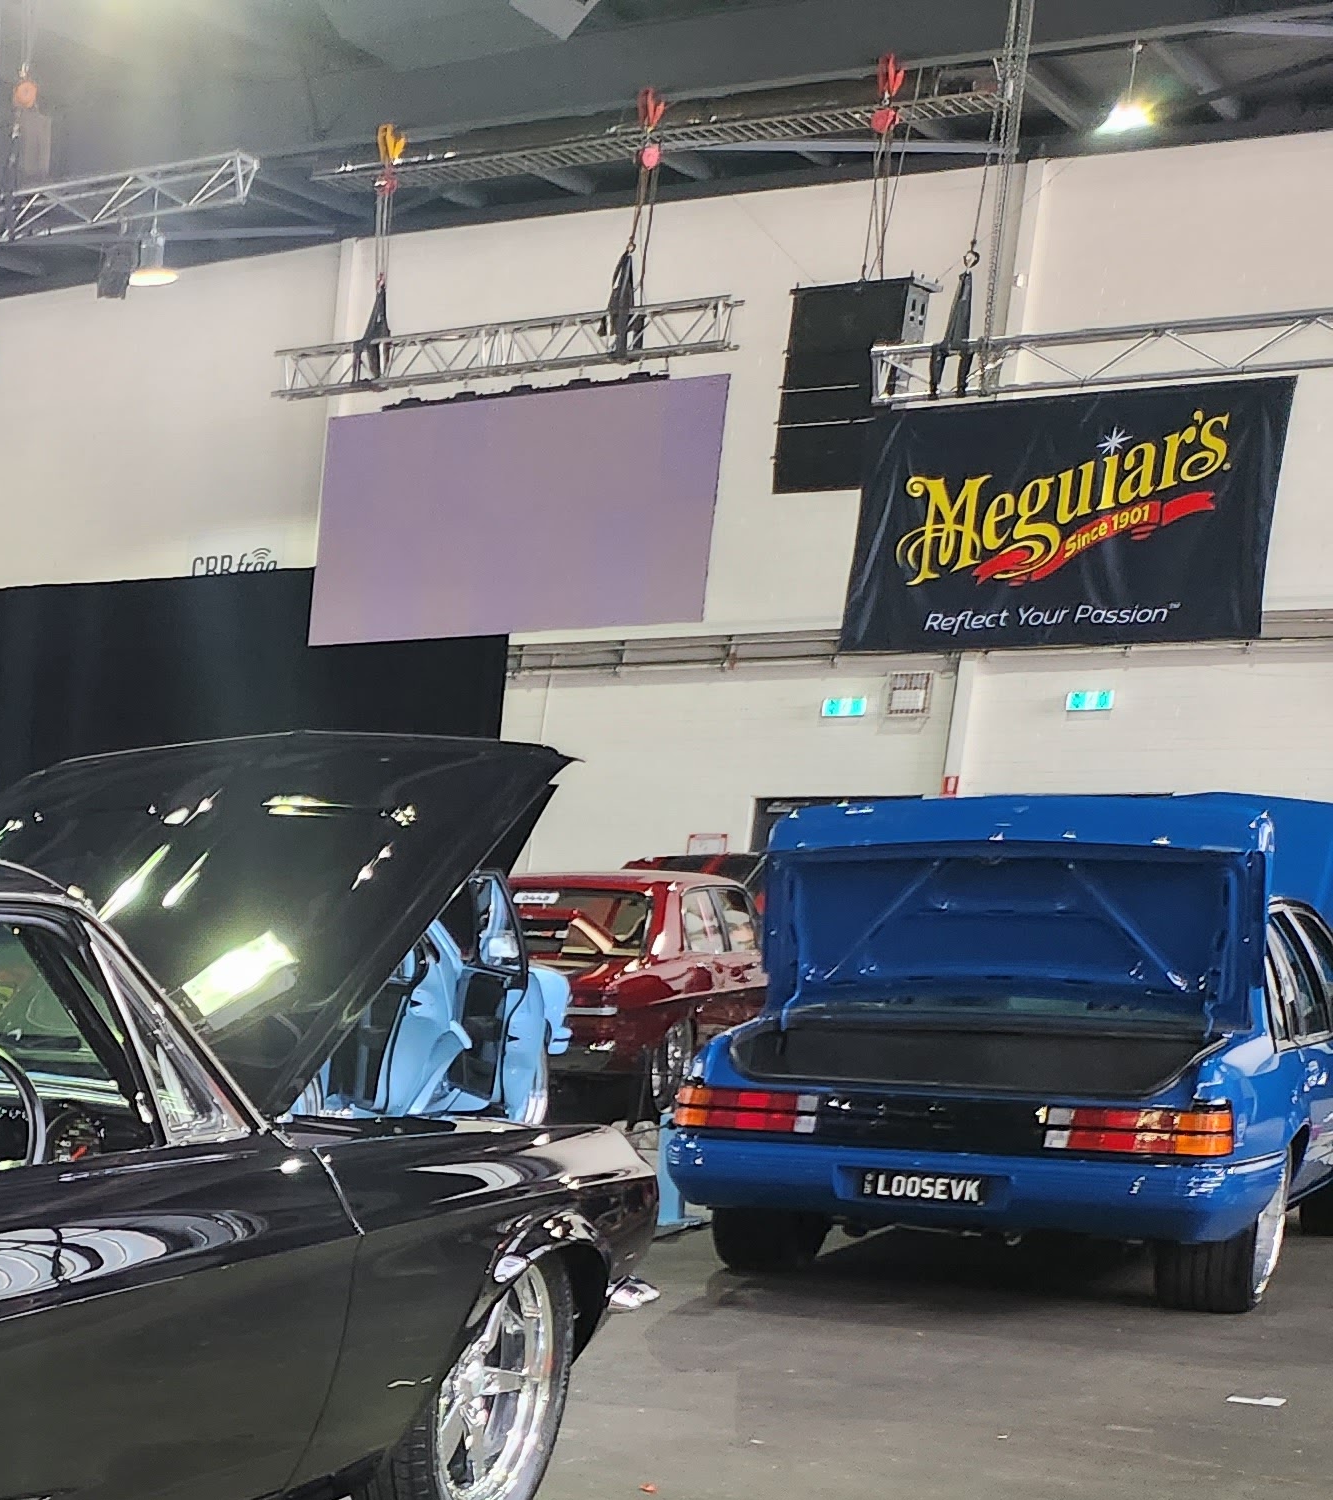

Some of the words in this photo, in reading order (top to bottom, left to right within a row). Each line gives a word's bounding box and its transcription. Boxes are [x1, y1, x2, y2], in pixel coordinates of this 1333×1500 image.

[896, 408, 1230, 587] Meguiar's
[1063, 521, 1110, 559] Since
[1112, 504, 1152, 532] 1901
[923, 608, 1010, 636] Reflect
[1018, 605, 1069, 626] Your
[876, 1174, 982, 1202] LOOSEVK
